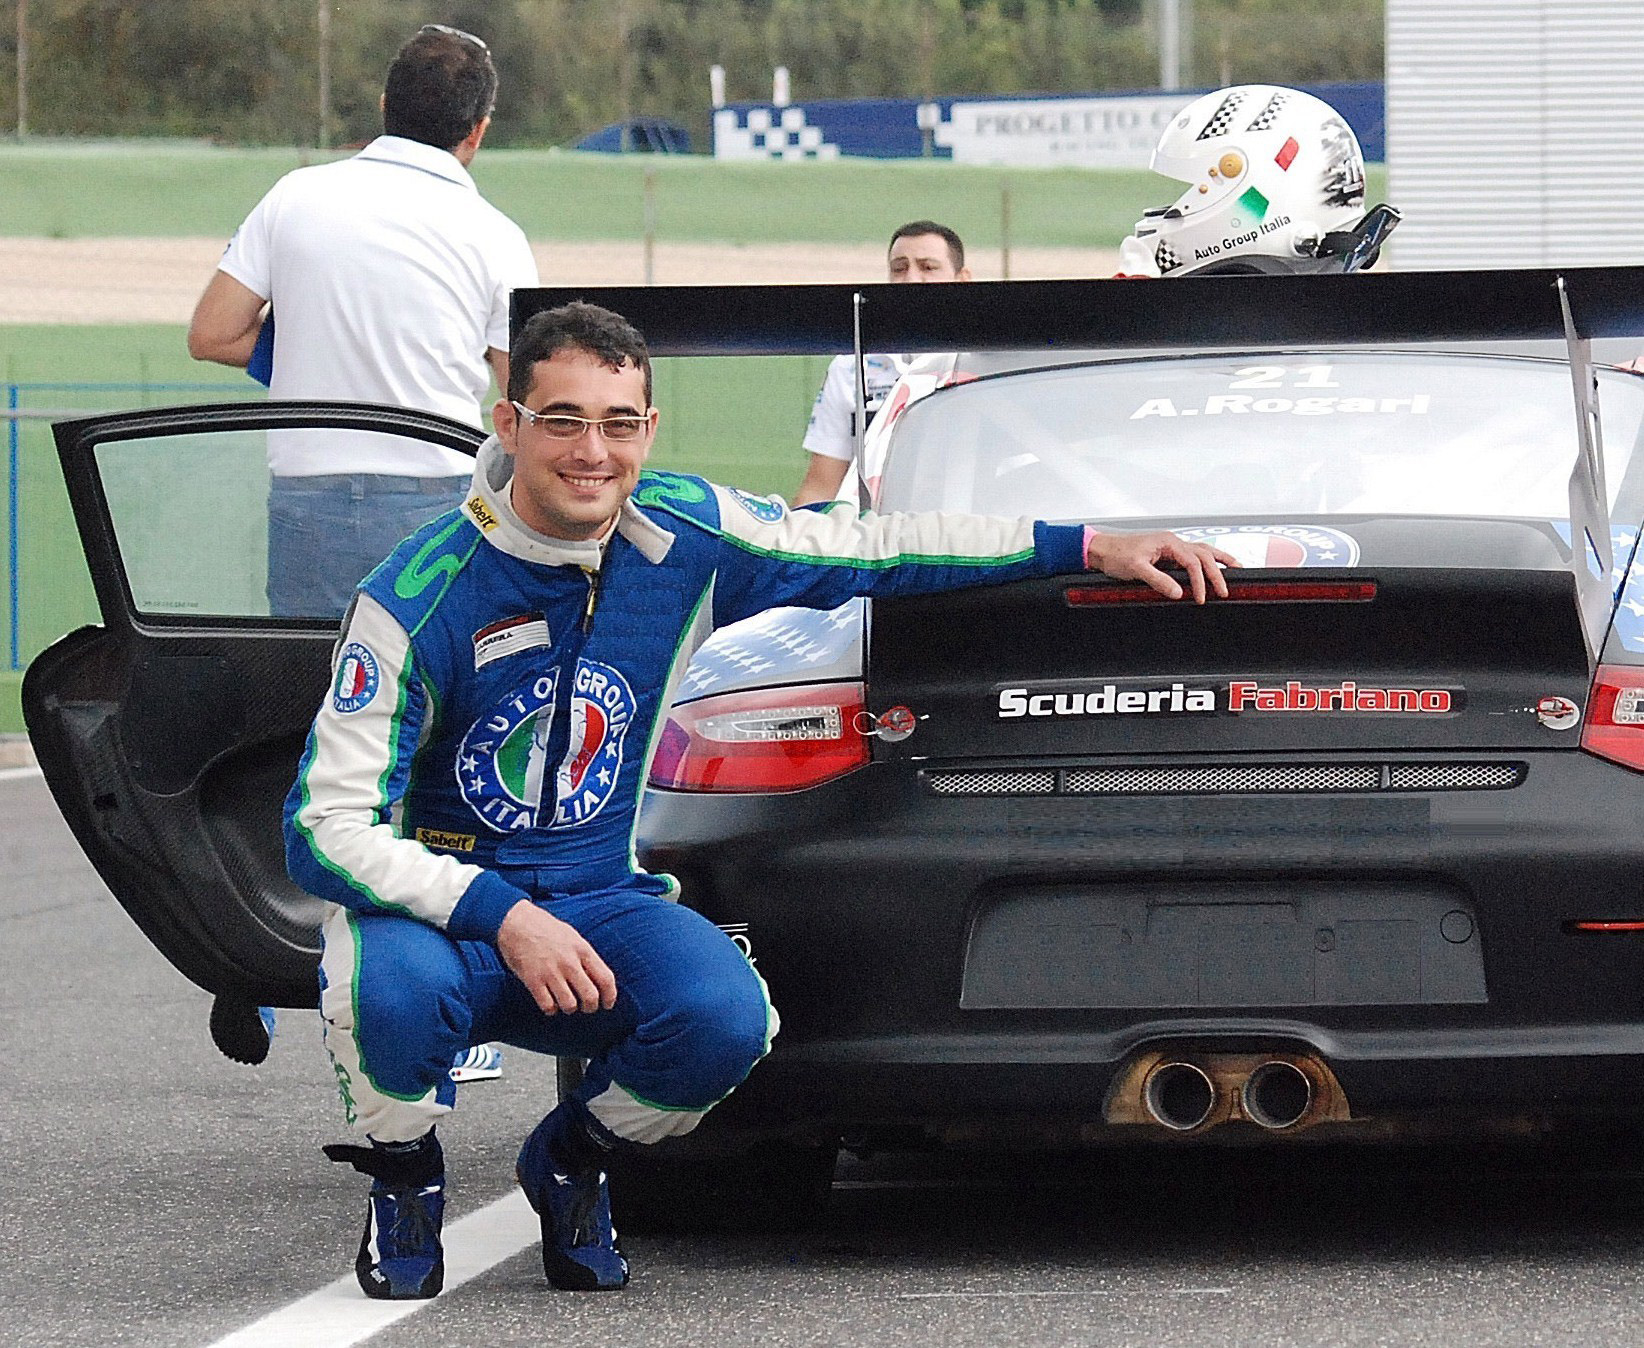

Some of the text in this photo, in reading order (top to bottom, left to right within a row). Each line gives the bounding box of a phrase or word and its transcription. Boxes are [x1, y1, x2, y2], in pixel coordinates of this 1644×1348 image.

[1194, 215, 1291, 260] Auto Group Italia
[1229, 366, 1340, 389] 21
[467, 497, 496, 528] Sabelt
[1239, 525, 1336, 549] GROUP
[469, 667, 627, 756] AUTO GROUP
[999, 681, 1451, 718] Scuderia Fabriano
[483, 789, 600, 830] ITALIA
[421, 830, 472, 850] Sabelt
